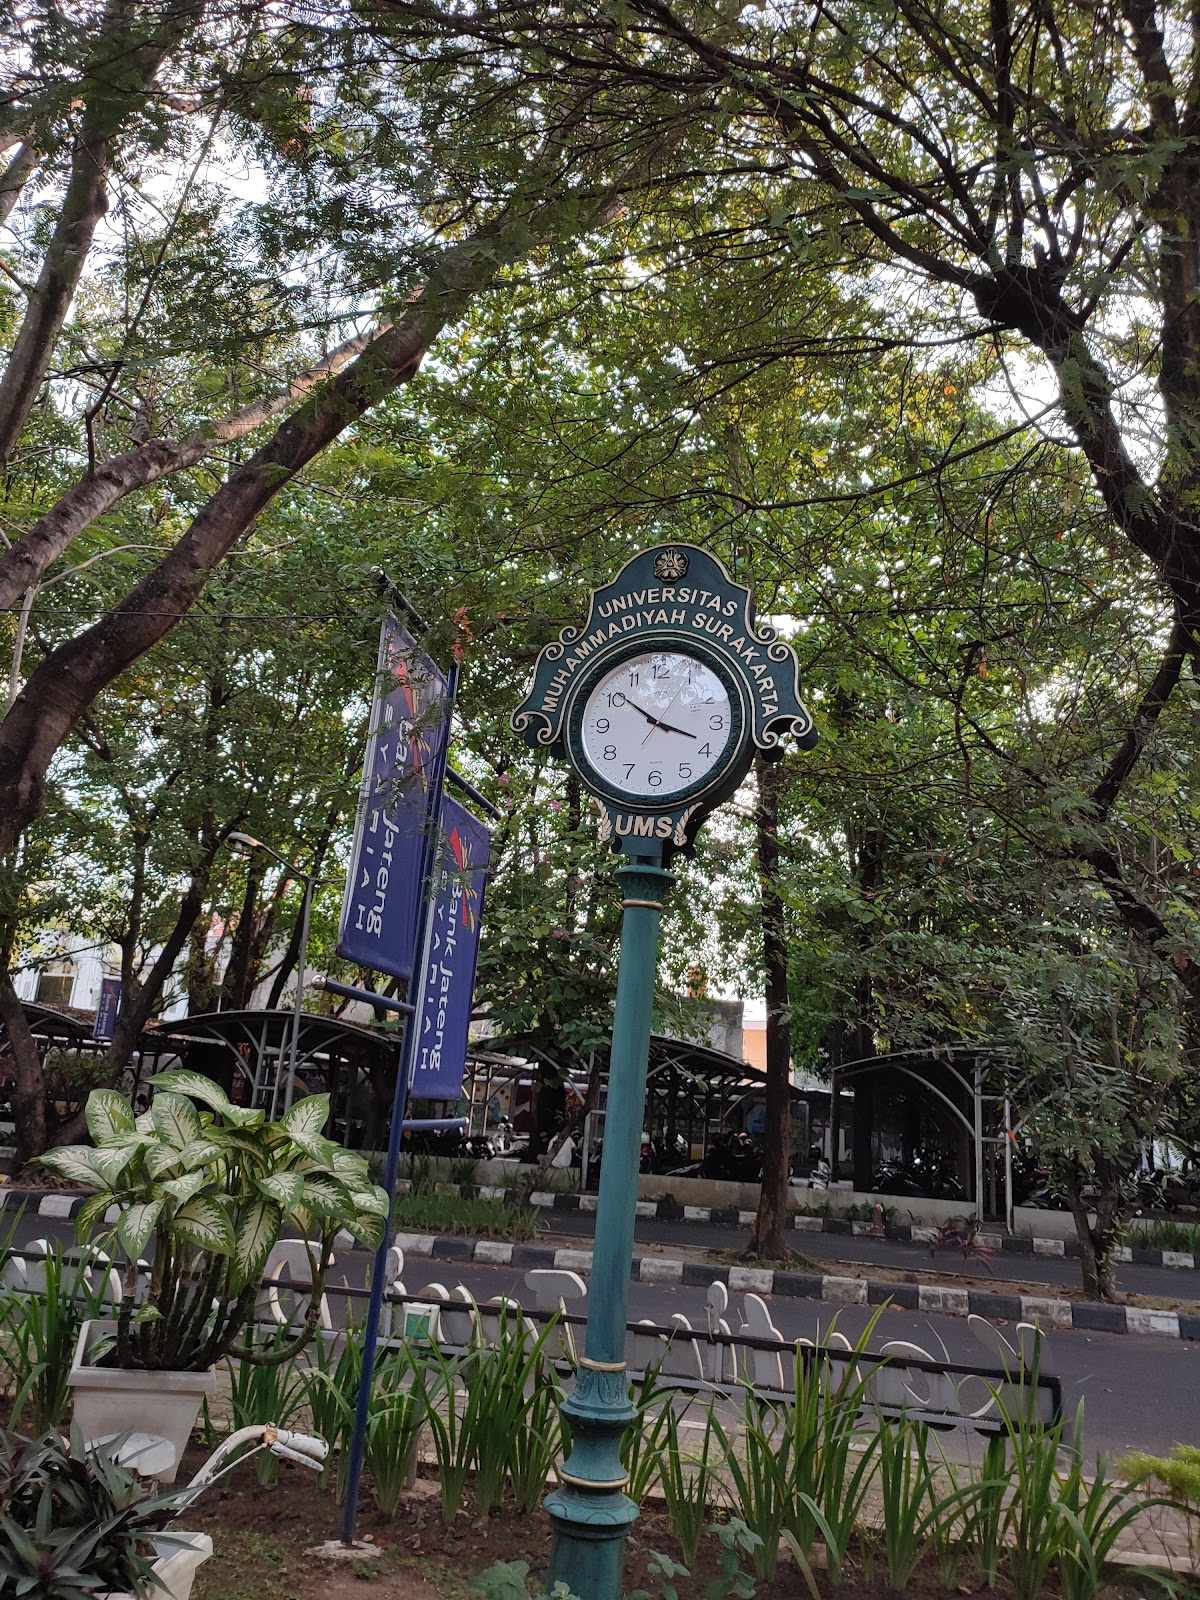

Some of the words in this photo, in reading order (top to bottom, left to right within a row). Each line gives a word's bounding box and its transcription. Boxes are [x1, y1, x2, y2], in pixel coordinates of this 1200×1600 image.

[598, 587, 738, 618] UNIVERSITAS
[541, 609, 685, 713] MUHAMMADIYAH
[691, 612, 779, 718] SURAKARTA
[652, 664, 670, 679] 12
[629, 673, 639, 687] 11
[607, 692, 626, 707] 10
[596, 718, 610, 733] 9
[709, 715, 723, 730] 3
[603, 745, 617, 760] 8
[698, 743, 712, 758] 4
[623, 764, 635, 779] 7
[648, 771, 662, 786] 6
[678, 763, 692, 779] 5
[614, 814, 672, 839] UMS
[367, 809, 400, 938] Jateng
[444, 877, 463, 957] Bank
[429, 960, 453, 1071] Jateng
